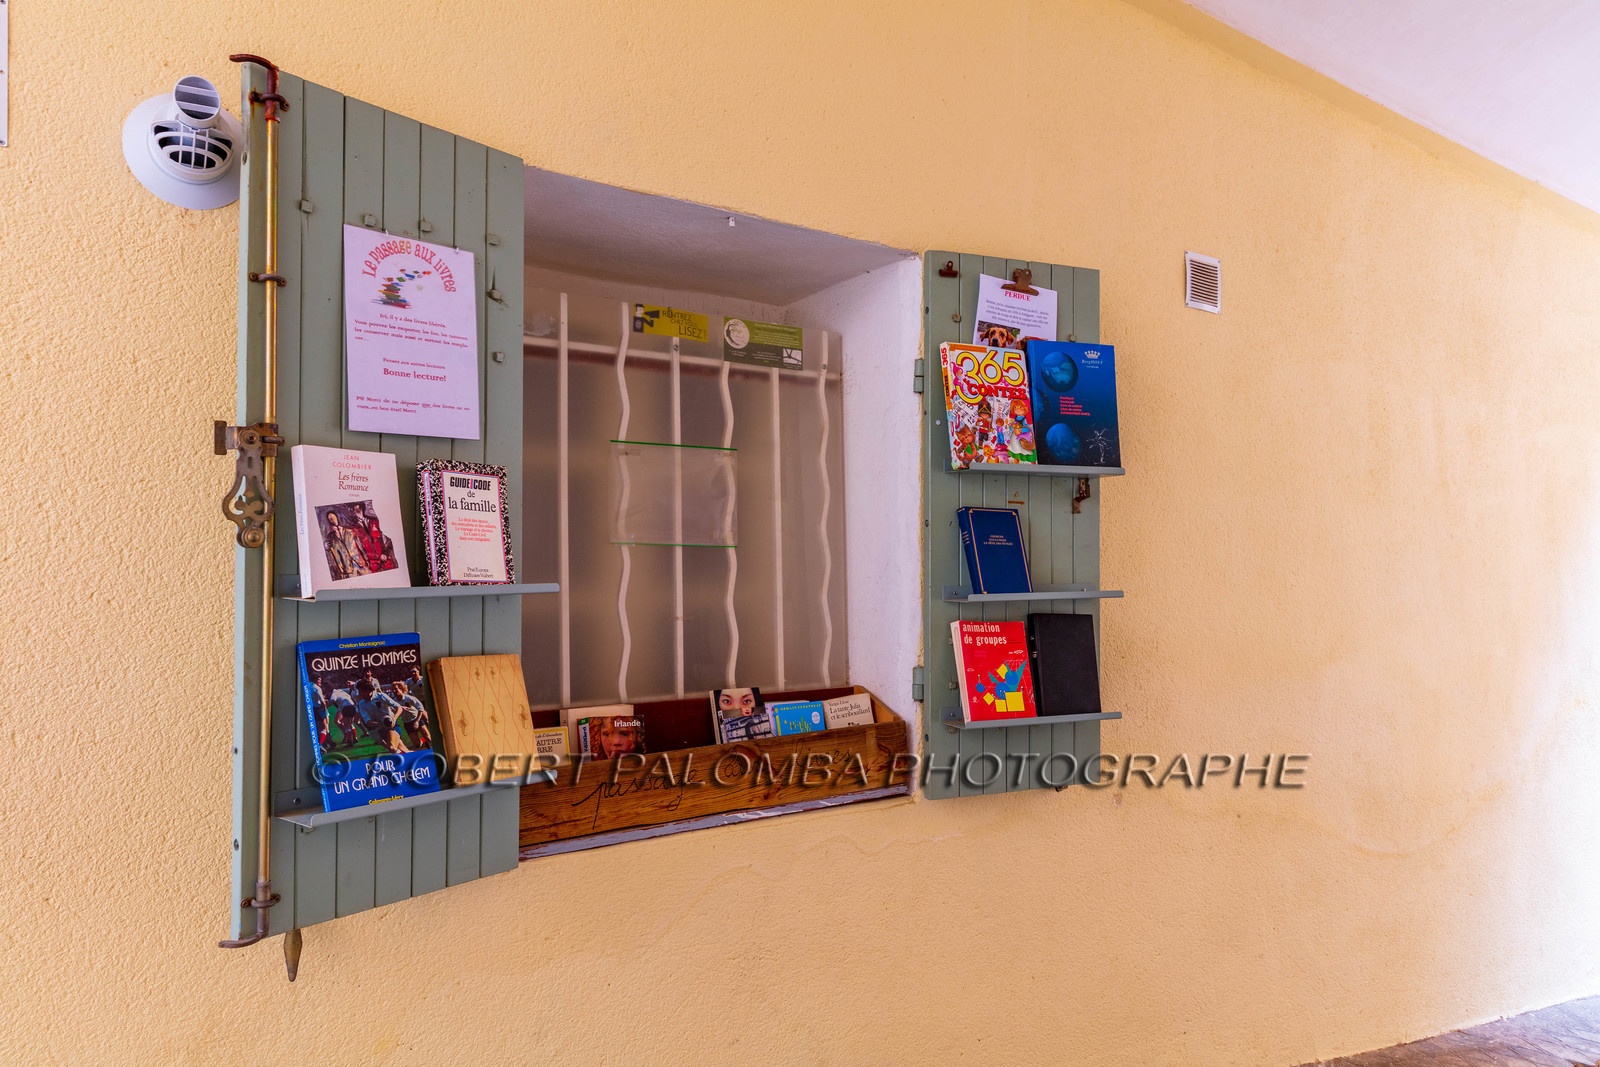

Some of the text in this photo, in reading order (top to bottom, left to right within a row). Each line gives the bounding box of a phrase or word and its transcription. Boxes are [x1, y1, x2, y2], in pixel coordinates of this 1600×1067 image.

[362, 240, 456, 292] Le passage aux livres
[1004, 290, 1031, 301] PERDUE
[662, 307, 691, 320] RENTREZ
[383, 367, 447, 382] Bonne lecture!
[956, 350, 1026, 405] 365
[967, 383, 1027, 400] CONTES
[332, 462, 372, 470] COLOMBIER
[338, 471, 369, 483] Les frères
[338, 481, 369, 492] Romance
[467, 490, 475, 498] de
[448, 497, 497, 513] la famille
[962, 622, 1001, 633] animation
[964, 634, 1007, 646] de groupes
[311, 655, 359, 672] QUINZE
[362, 649, 417, 668] HOMMES
[841, 707, 870, 718] scribouillard
[614, 719, 641, 728] Irlande
[365, 759, 396, 775] POUR
[334, 766, 430, 794] UN GRAND CHELEM
[571, 768, 704, 830] passage
